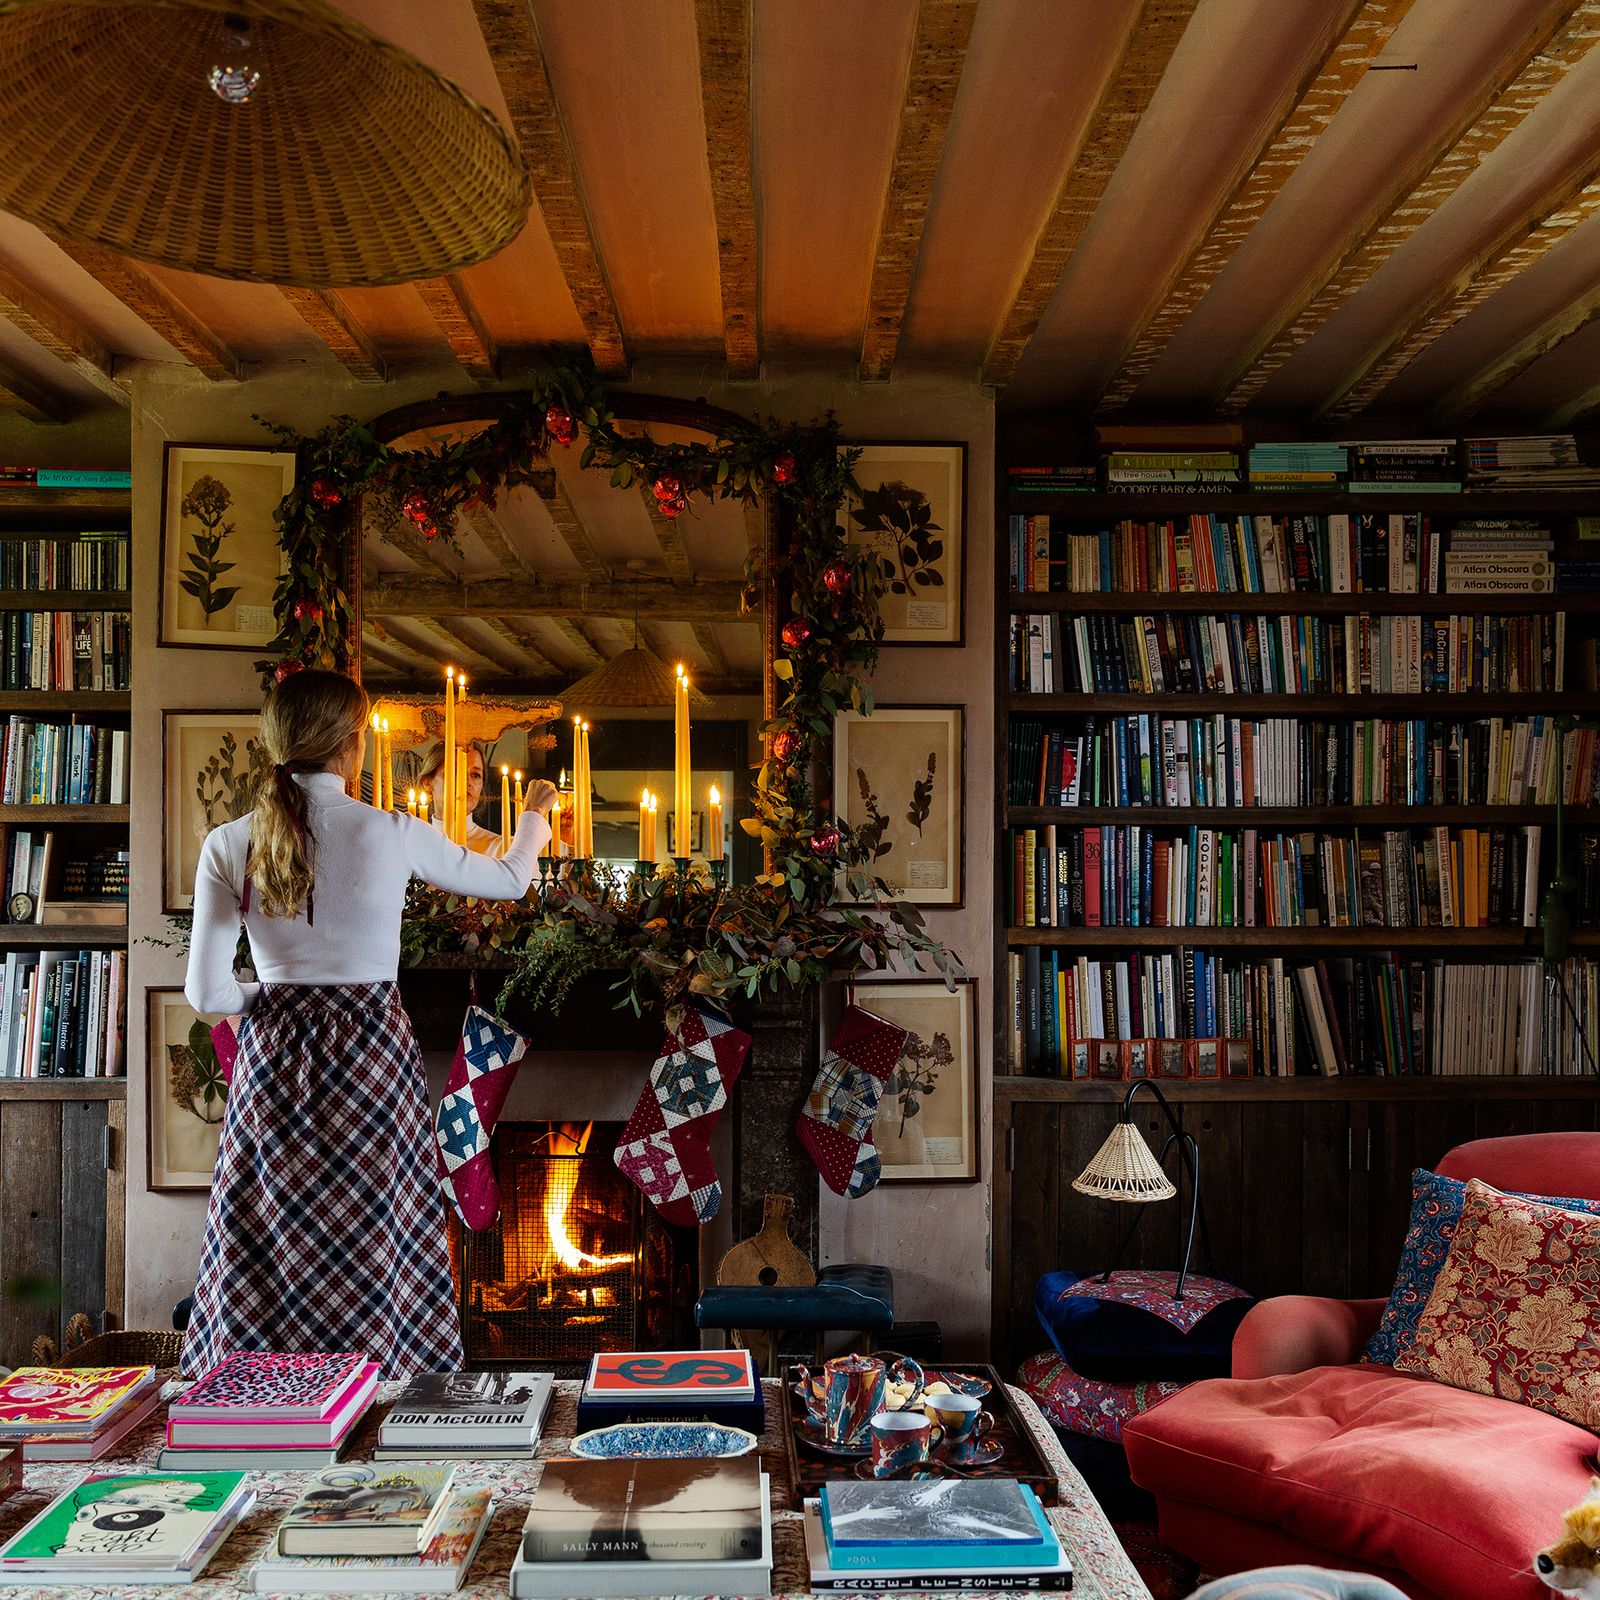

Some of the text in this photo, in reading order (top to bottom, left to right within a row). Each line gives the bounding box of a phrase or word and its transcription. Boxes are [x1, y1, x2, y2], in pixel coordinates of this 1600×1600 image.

[1124, 458, 1131, 467] A
[1124, 470, 1168, 478] tree houses
[1106, 484, 1233, 494] GOODBYE BABY & AMEN
[1475, 521, 1509, 529] WILDING
[1463, 565, 1529, 573] Atlas Obscura
[1464, 580, 1529, 589] Atlas Obscura
[75, 641, 91, 650] LIFE
[1437, 629, 1447, 673] OxCrimes
[1148, 638, 1158, 673] PAKISTAN
[1165, 732, 1176, 778] WHITE TIGER
[73, 754, 81, 778] Spark
[1086, 842, 1100, 858] 36
[1199, 834, 1210, 893] RODHAM
[1184, 950, 1195, 1007] LOULOU
[1104, 969, 1115, 1032] BOOK OF BRITISH
[60, 981, 73, 1050] The Iconic Interior
[389, 1413, 525, 1425] DON McCULLIN
[562, 1540, 708, 1552] SALLY MANN thousand crossings
[847, 1556, 877, 1565] POOLS
[833, 1576, 1041, 1590] RACHEL FEINSTEIN
